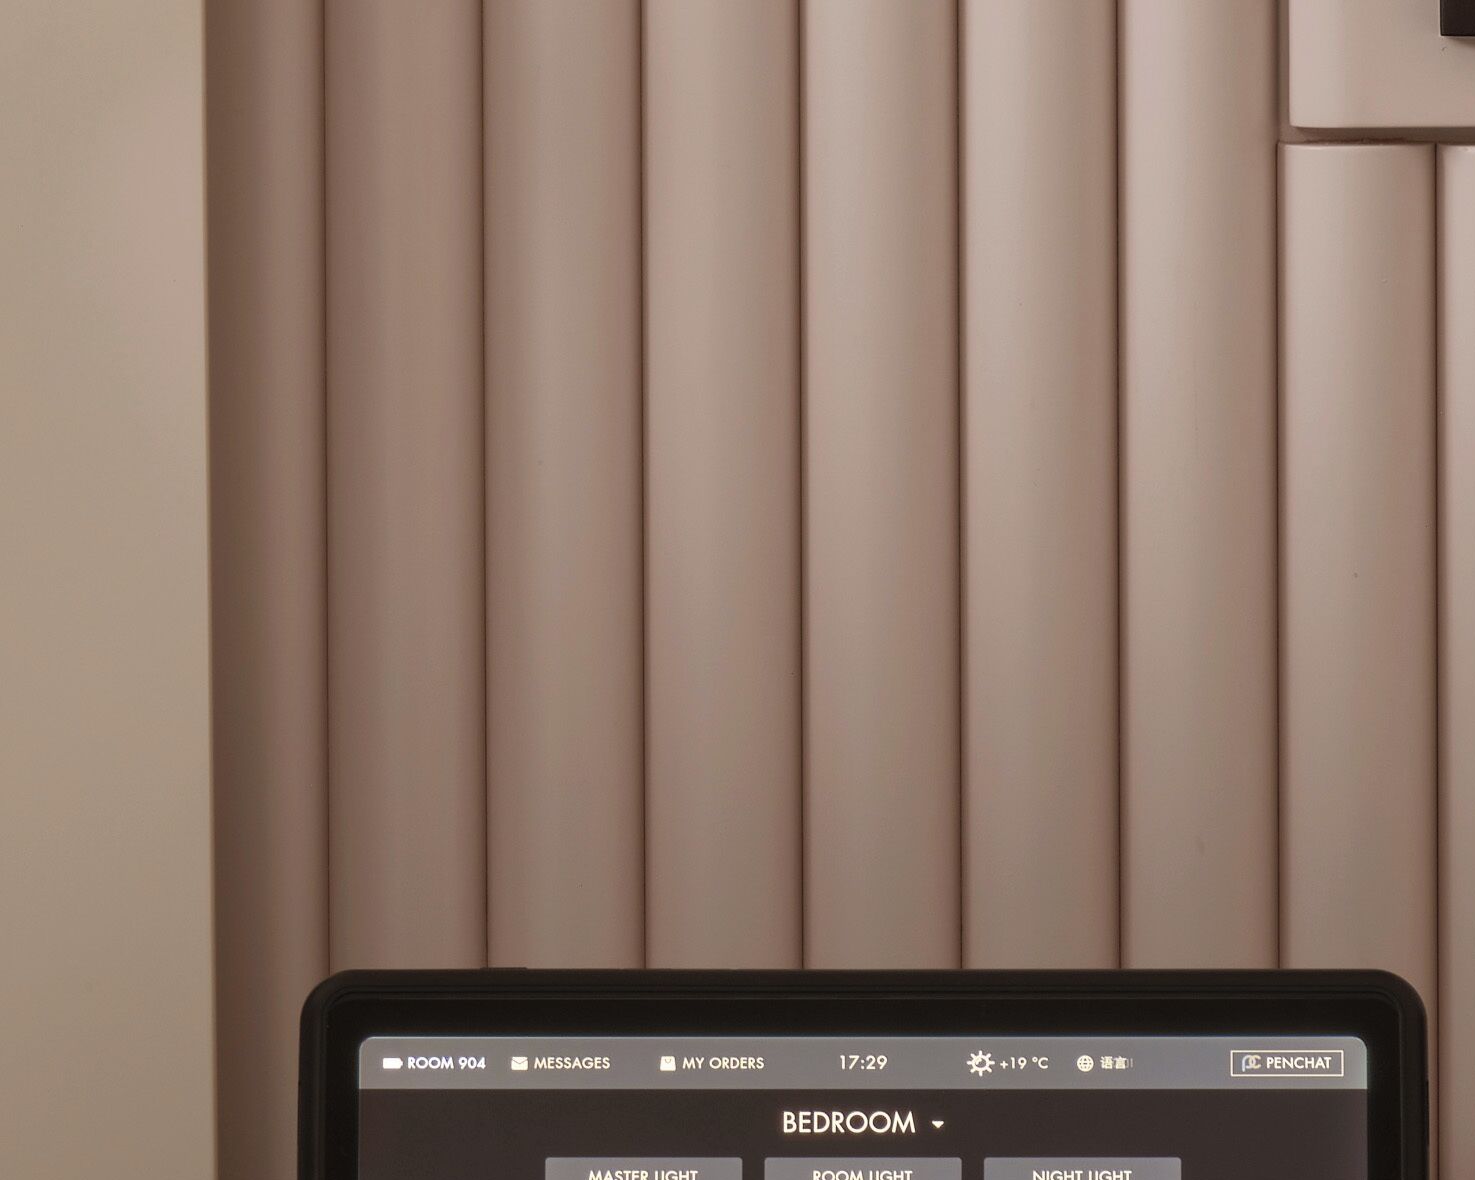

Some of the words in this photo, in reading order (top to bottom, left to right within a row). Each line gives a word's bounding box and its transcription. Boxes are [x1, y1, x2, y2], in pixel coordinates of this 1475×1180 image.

[408, 1057, 454, 1069] ROOM
[459, 1057, 485, 1069] 904
[534, 1057, 610, 1069] MESSAGES
[683, 1057, 704, 1069] MY
[709, 1057, 764, 1069] ORDERS
[840, 1055, 887, 1069] 17:29
[1000, 1057, 1026, 1069] +19
[1100, 1056, 1128, 1069] 语言
[1267, 1057, 1331, 1069] PENCHAT
[784, 1111, 915, 1133] BEDROOM
